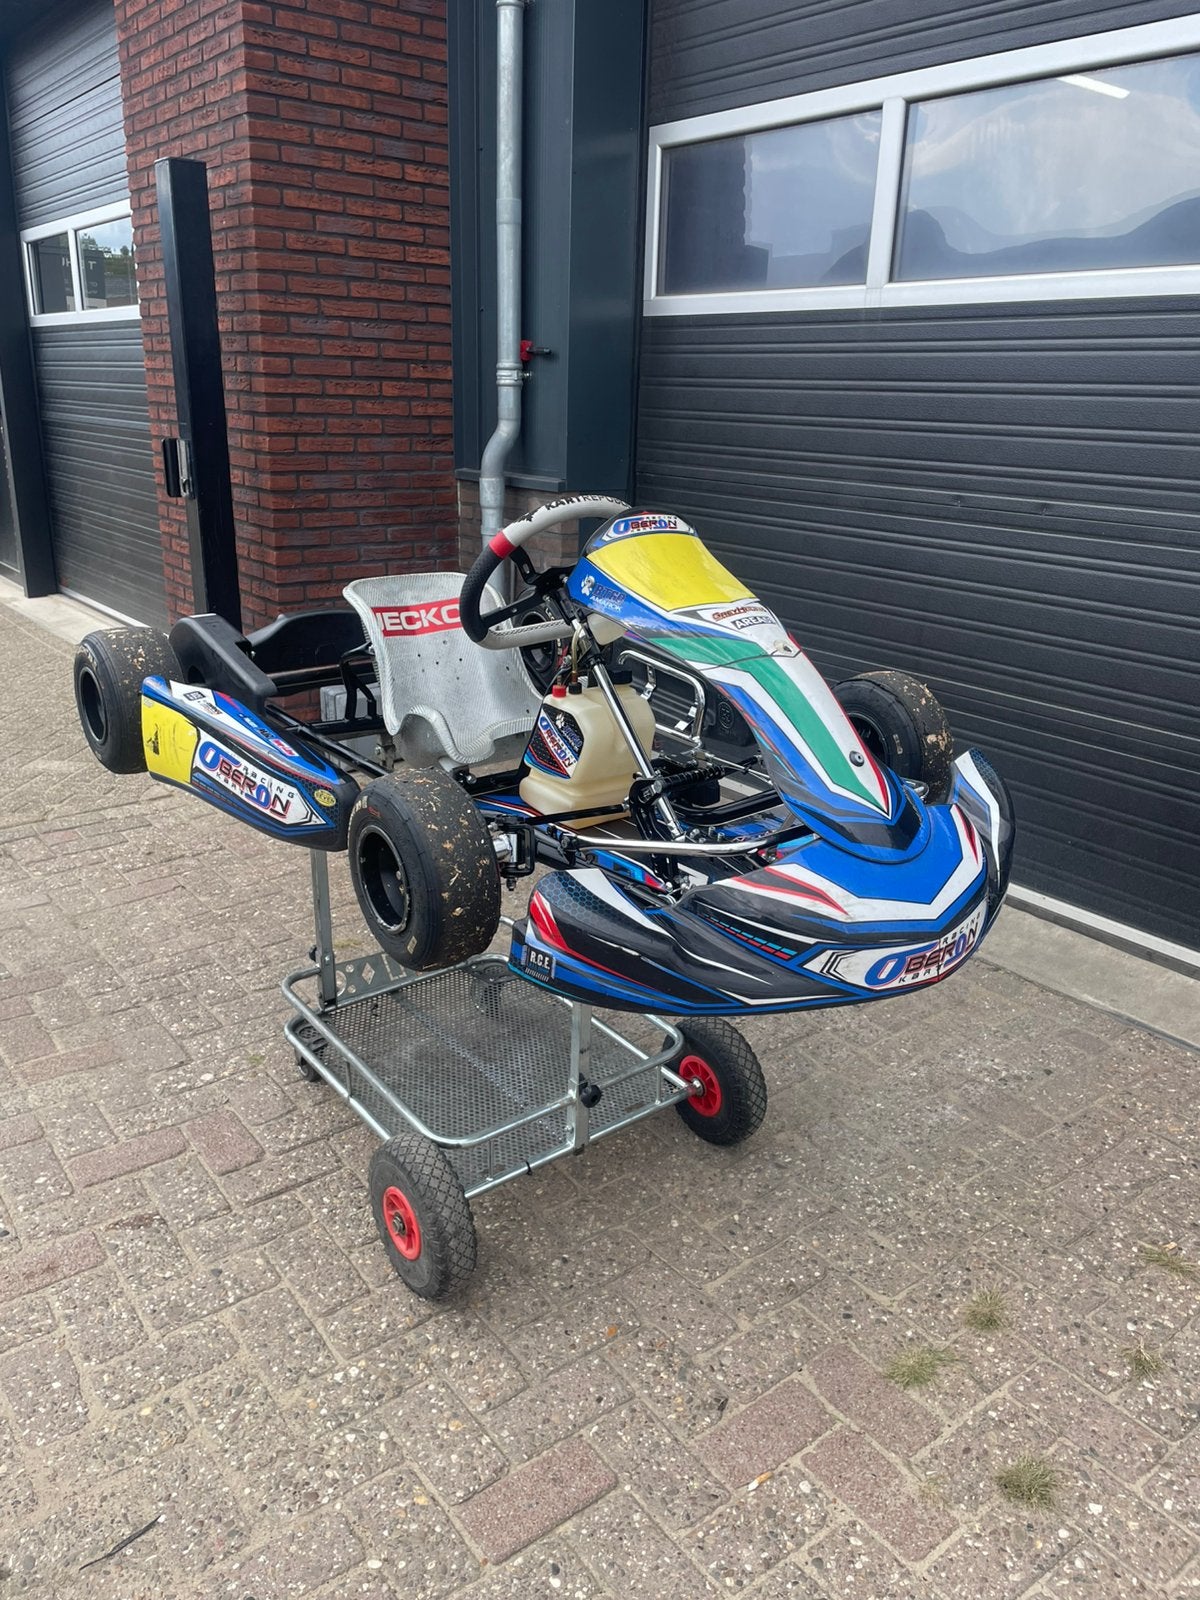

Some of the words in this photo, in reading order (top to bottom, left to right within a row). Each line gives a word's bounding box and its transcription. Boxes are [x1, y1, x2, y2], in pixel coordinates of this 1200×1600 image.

[612, 517, 678, 535] OBERON
[198, 740, 291, 818] OBERON
[530, 951, 551, 970] R.C.E.
[864, 921, 979, 987] OBERON
